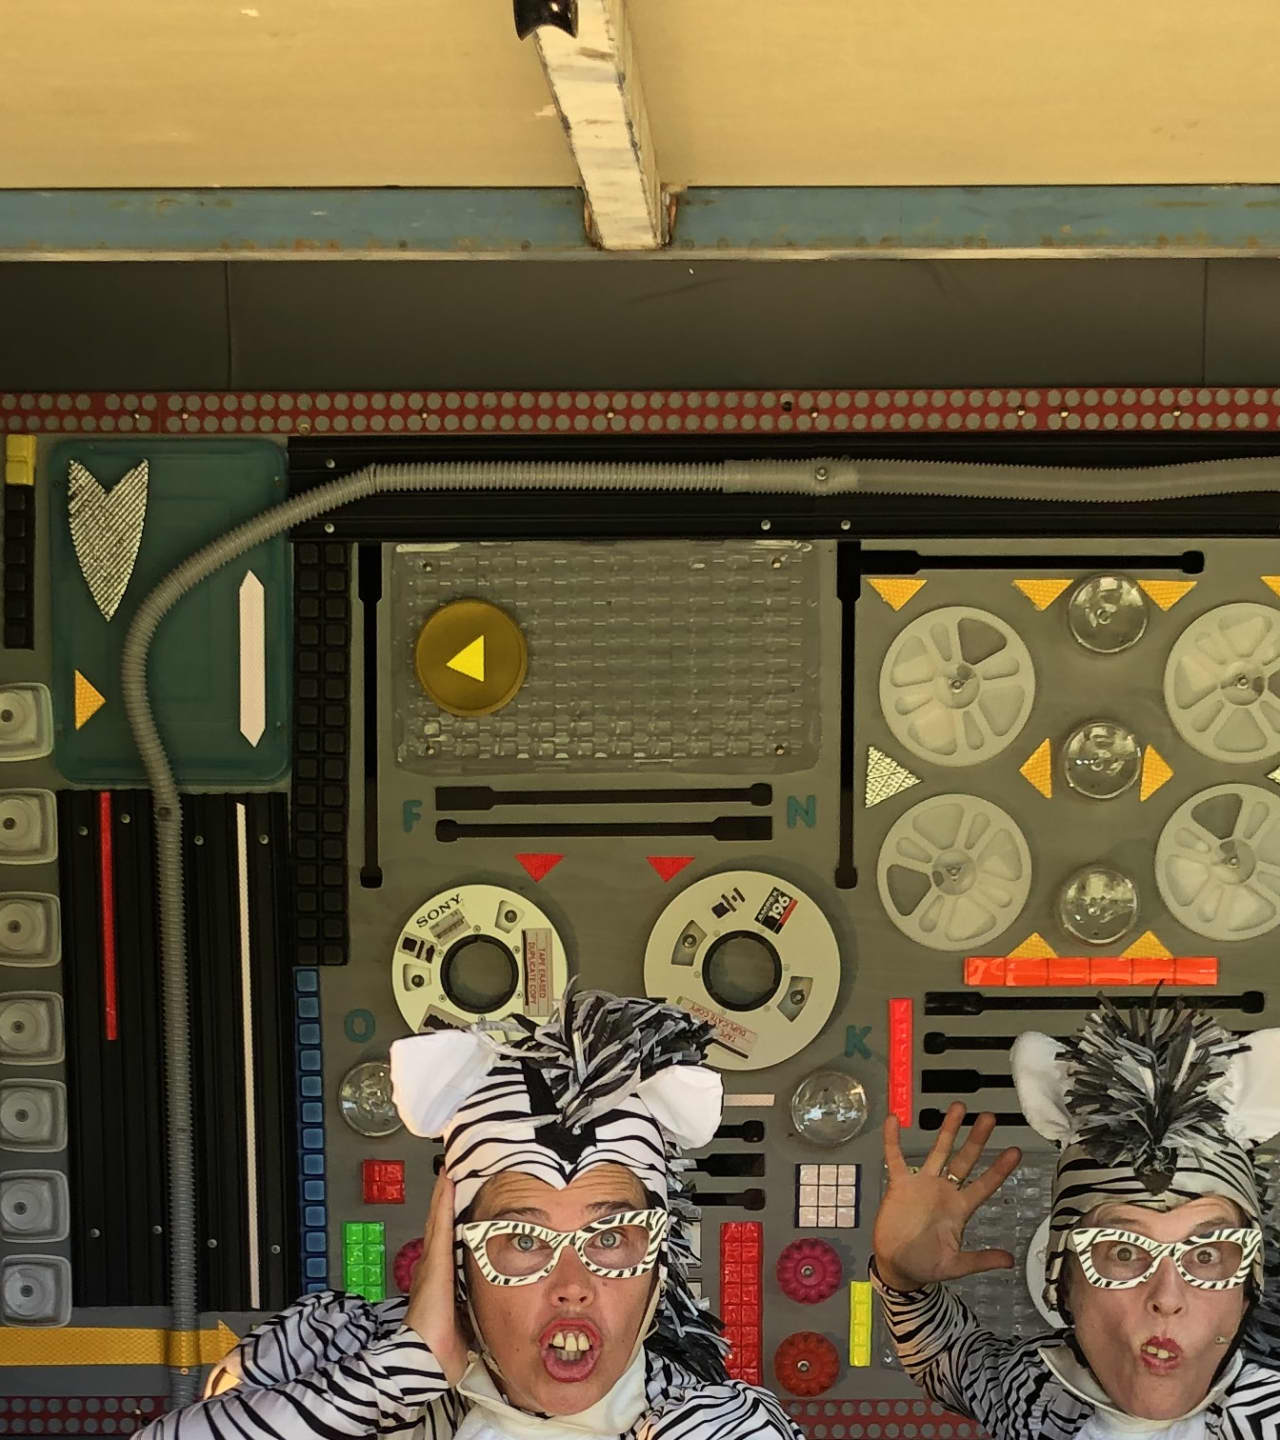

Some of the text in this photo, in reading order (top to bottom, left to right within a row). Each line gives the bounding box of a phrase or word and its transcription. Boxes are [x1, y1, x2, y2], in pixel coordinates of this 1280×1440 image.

[402, 799, 423, 833] F
[786, 794, 817, 829] N
[416, 893, 463, 929] SONY
[768, 895, 790, 920] 196
[527, 942, 537, 1005] DUPLICATE COPY
[844, 1024, 873, 1060] K
